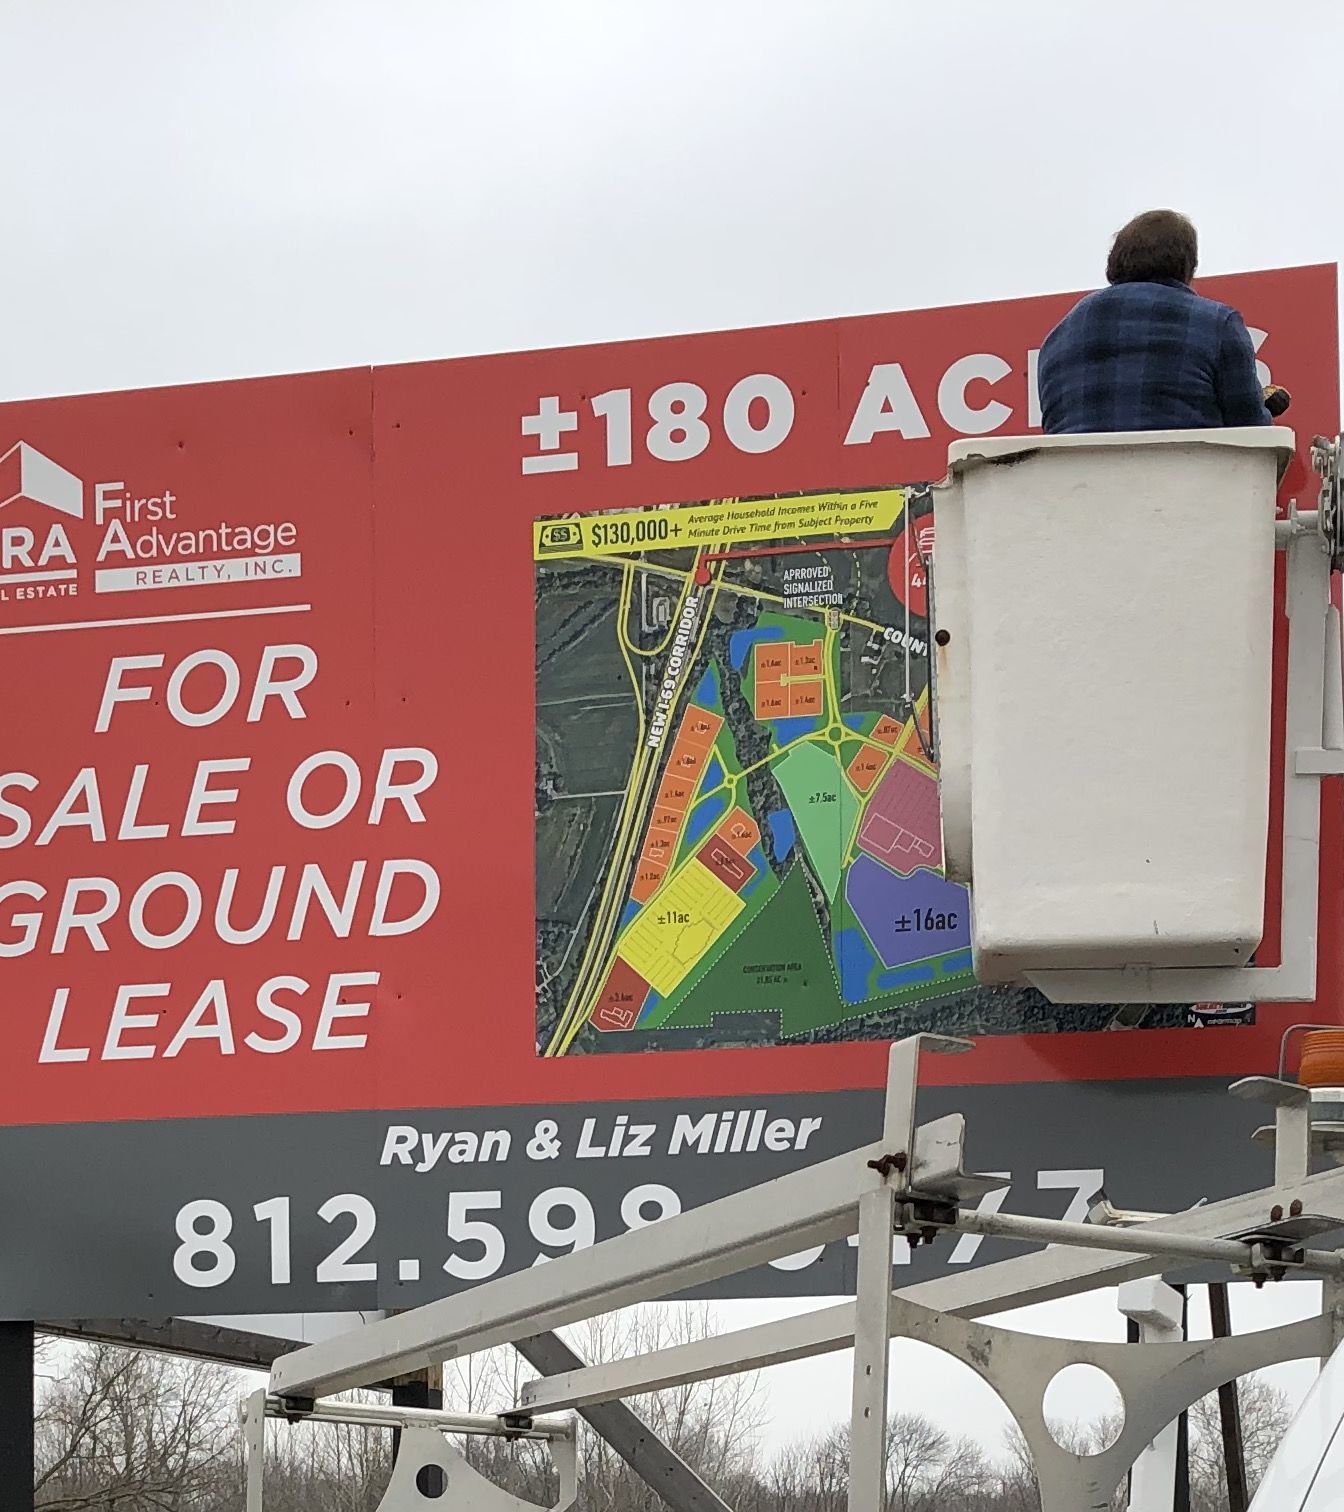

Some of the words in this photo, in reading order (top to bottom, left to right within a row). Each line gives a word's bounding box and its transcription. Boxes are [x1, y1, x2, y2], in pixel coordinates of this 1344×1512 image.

[521, 373, 795, 475] ±180
[95, 482, 177, 525] First
[688, 511, 724, 524] Average
[727, 507, 775, 521] Household
[778, 504, 815, 516] Incomes
[818, 501, 847, 512] Within
[850, 503, 856, 511] a
[859, 499, 878, 510] Five
[96, 518, 297, 562] Advantage
[592, 519, 682, 548] $130,000+
[688, 526, 720, 538] Minute
[722, 523, 746, 536] Drive
[749, 521, 771, 533] Time
[773, 520, 795, 532] from
[798, 517, 832, 530] Subject
[834, 515, 874, 529] Property
[136, 564, 232, 586] REALTY,
[244, 558, 293, 577] INC.
[16, 583, 77, 600] ESTATE
[783, 580, 833, 594] SIGNALIZED
[783, 593, 843, 609] INTERSECTION
[647, 711, 667, 748] NEW
[658, 678, 676, 711] I-69
[667, 596, 699, 676] CORRIDOR
[94, 644, 318, 733] FOR
[286, 747, 439, 829] OR
[657, 909, 690, 925] ±11ac
[894, 907, 958, 933] ±16ac
[38, 972, 381, 1063] LEASE
[379, 1124, 513, 1172] Ryan
[526, 1119, 562, 1160] &
[576, 1115, 657, 1158] Liz
[668, 1108, 823, 1155] Miller
